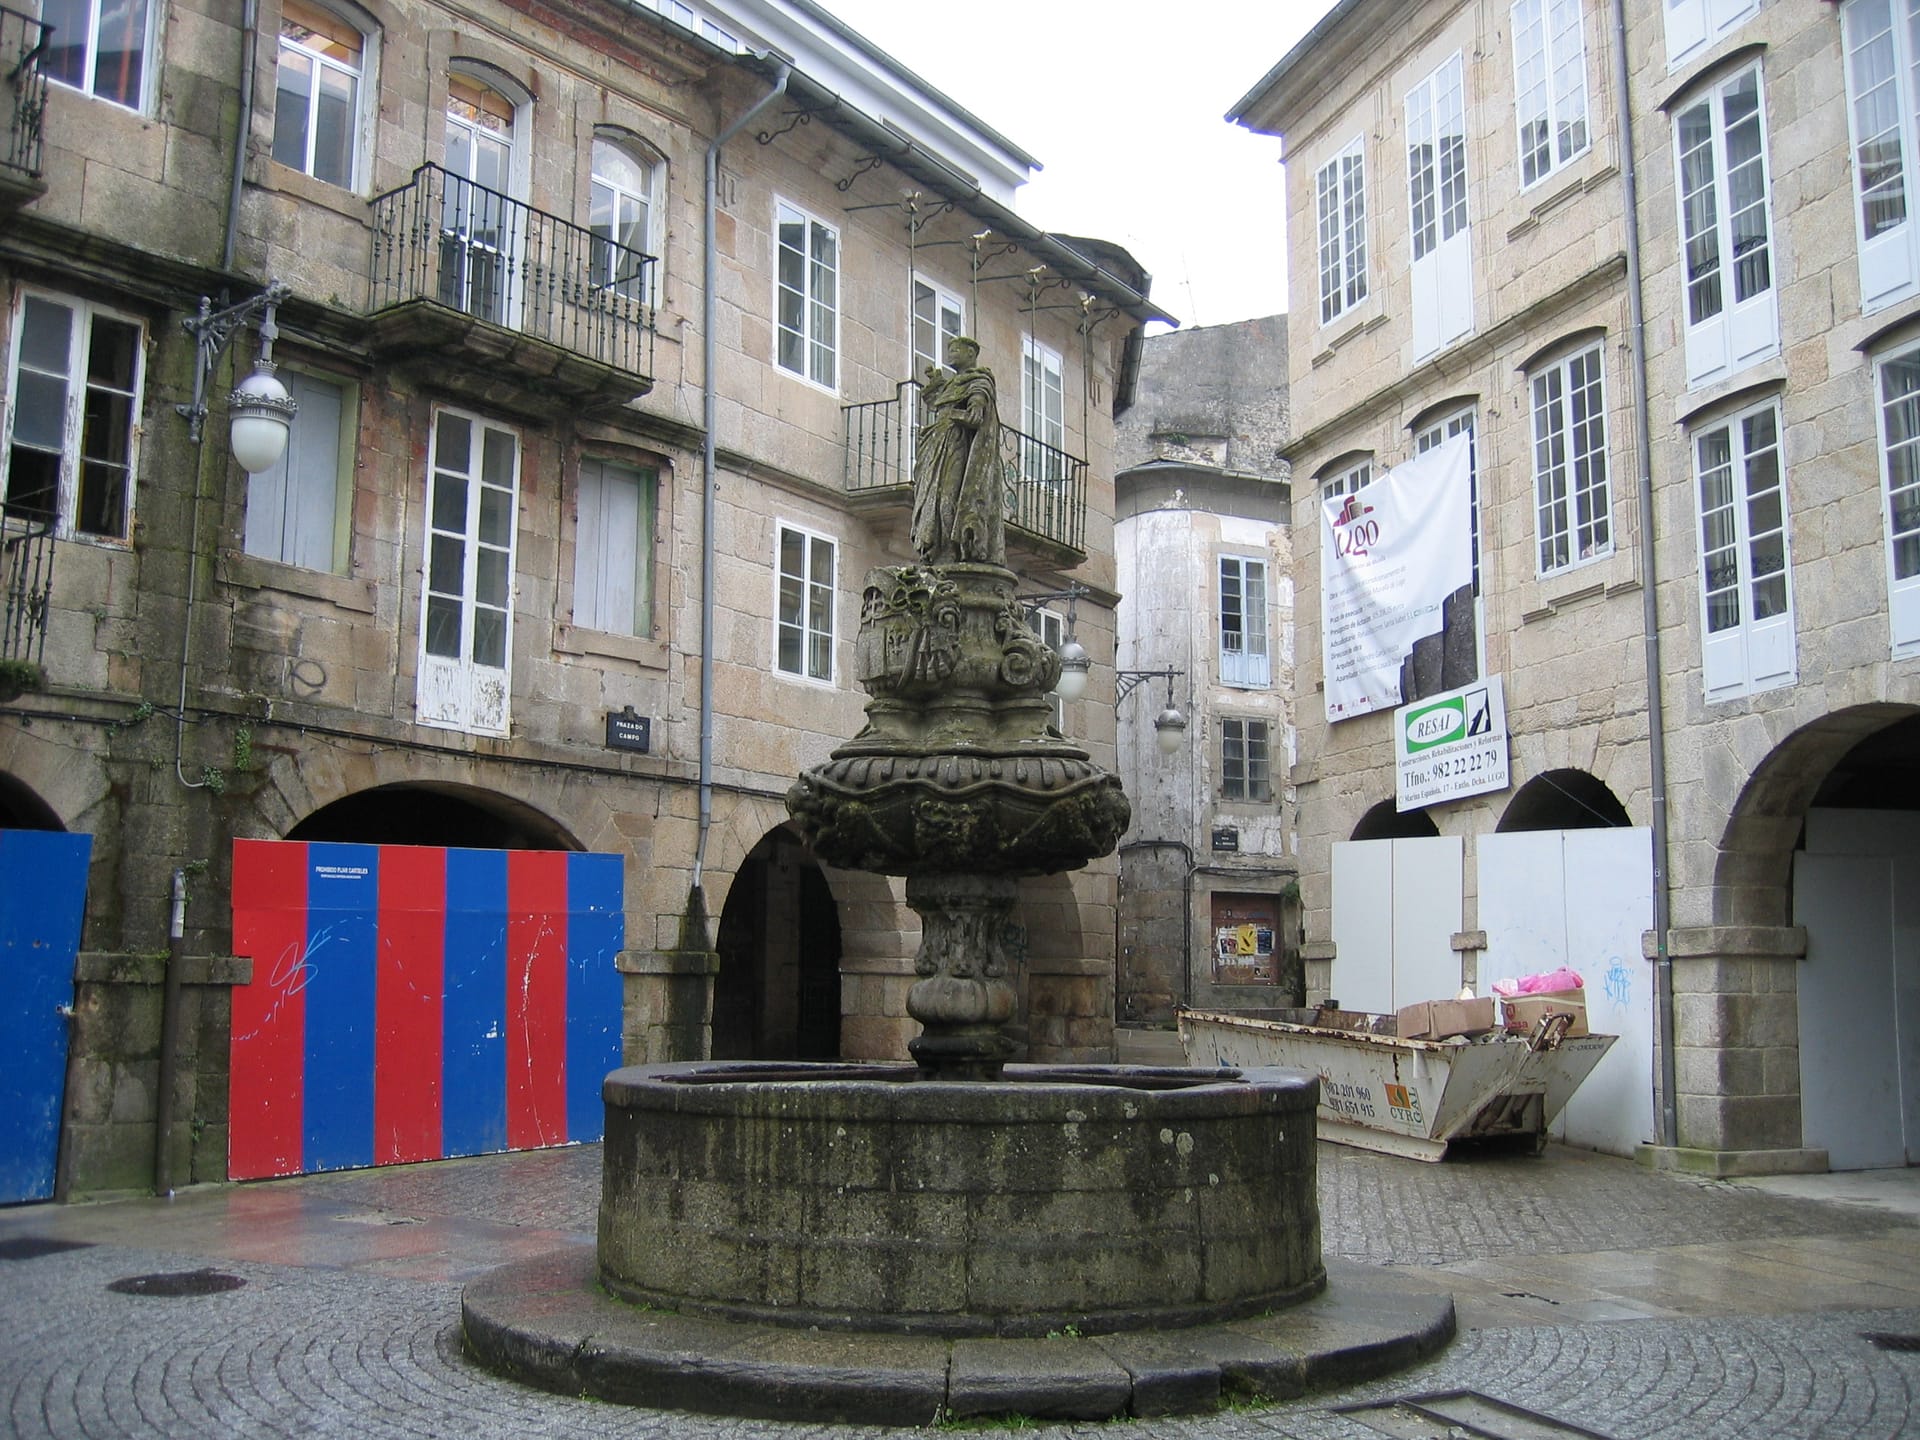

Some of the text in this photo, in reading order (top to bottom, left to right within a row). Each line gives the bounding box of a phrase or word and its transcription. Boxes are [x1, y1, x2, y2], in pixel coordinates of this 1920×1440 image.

[1332, 519, 1380, 560] lugo
[619, 732, 640, 741] CAMPO
[1418, 714, 1451, 738] RESAI
[1404, 749, 1497, 788] Tfno.: 982 22 22 79
[1443, 783, 1450, 793] 17
[1487, 770, 1505, 782] LUGO
